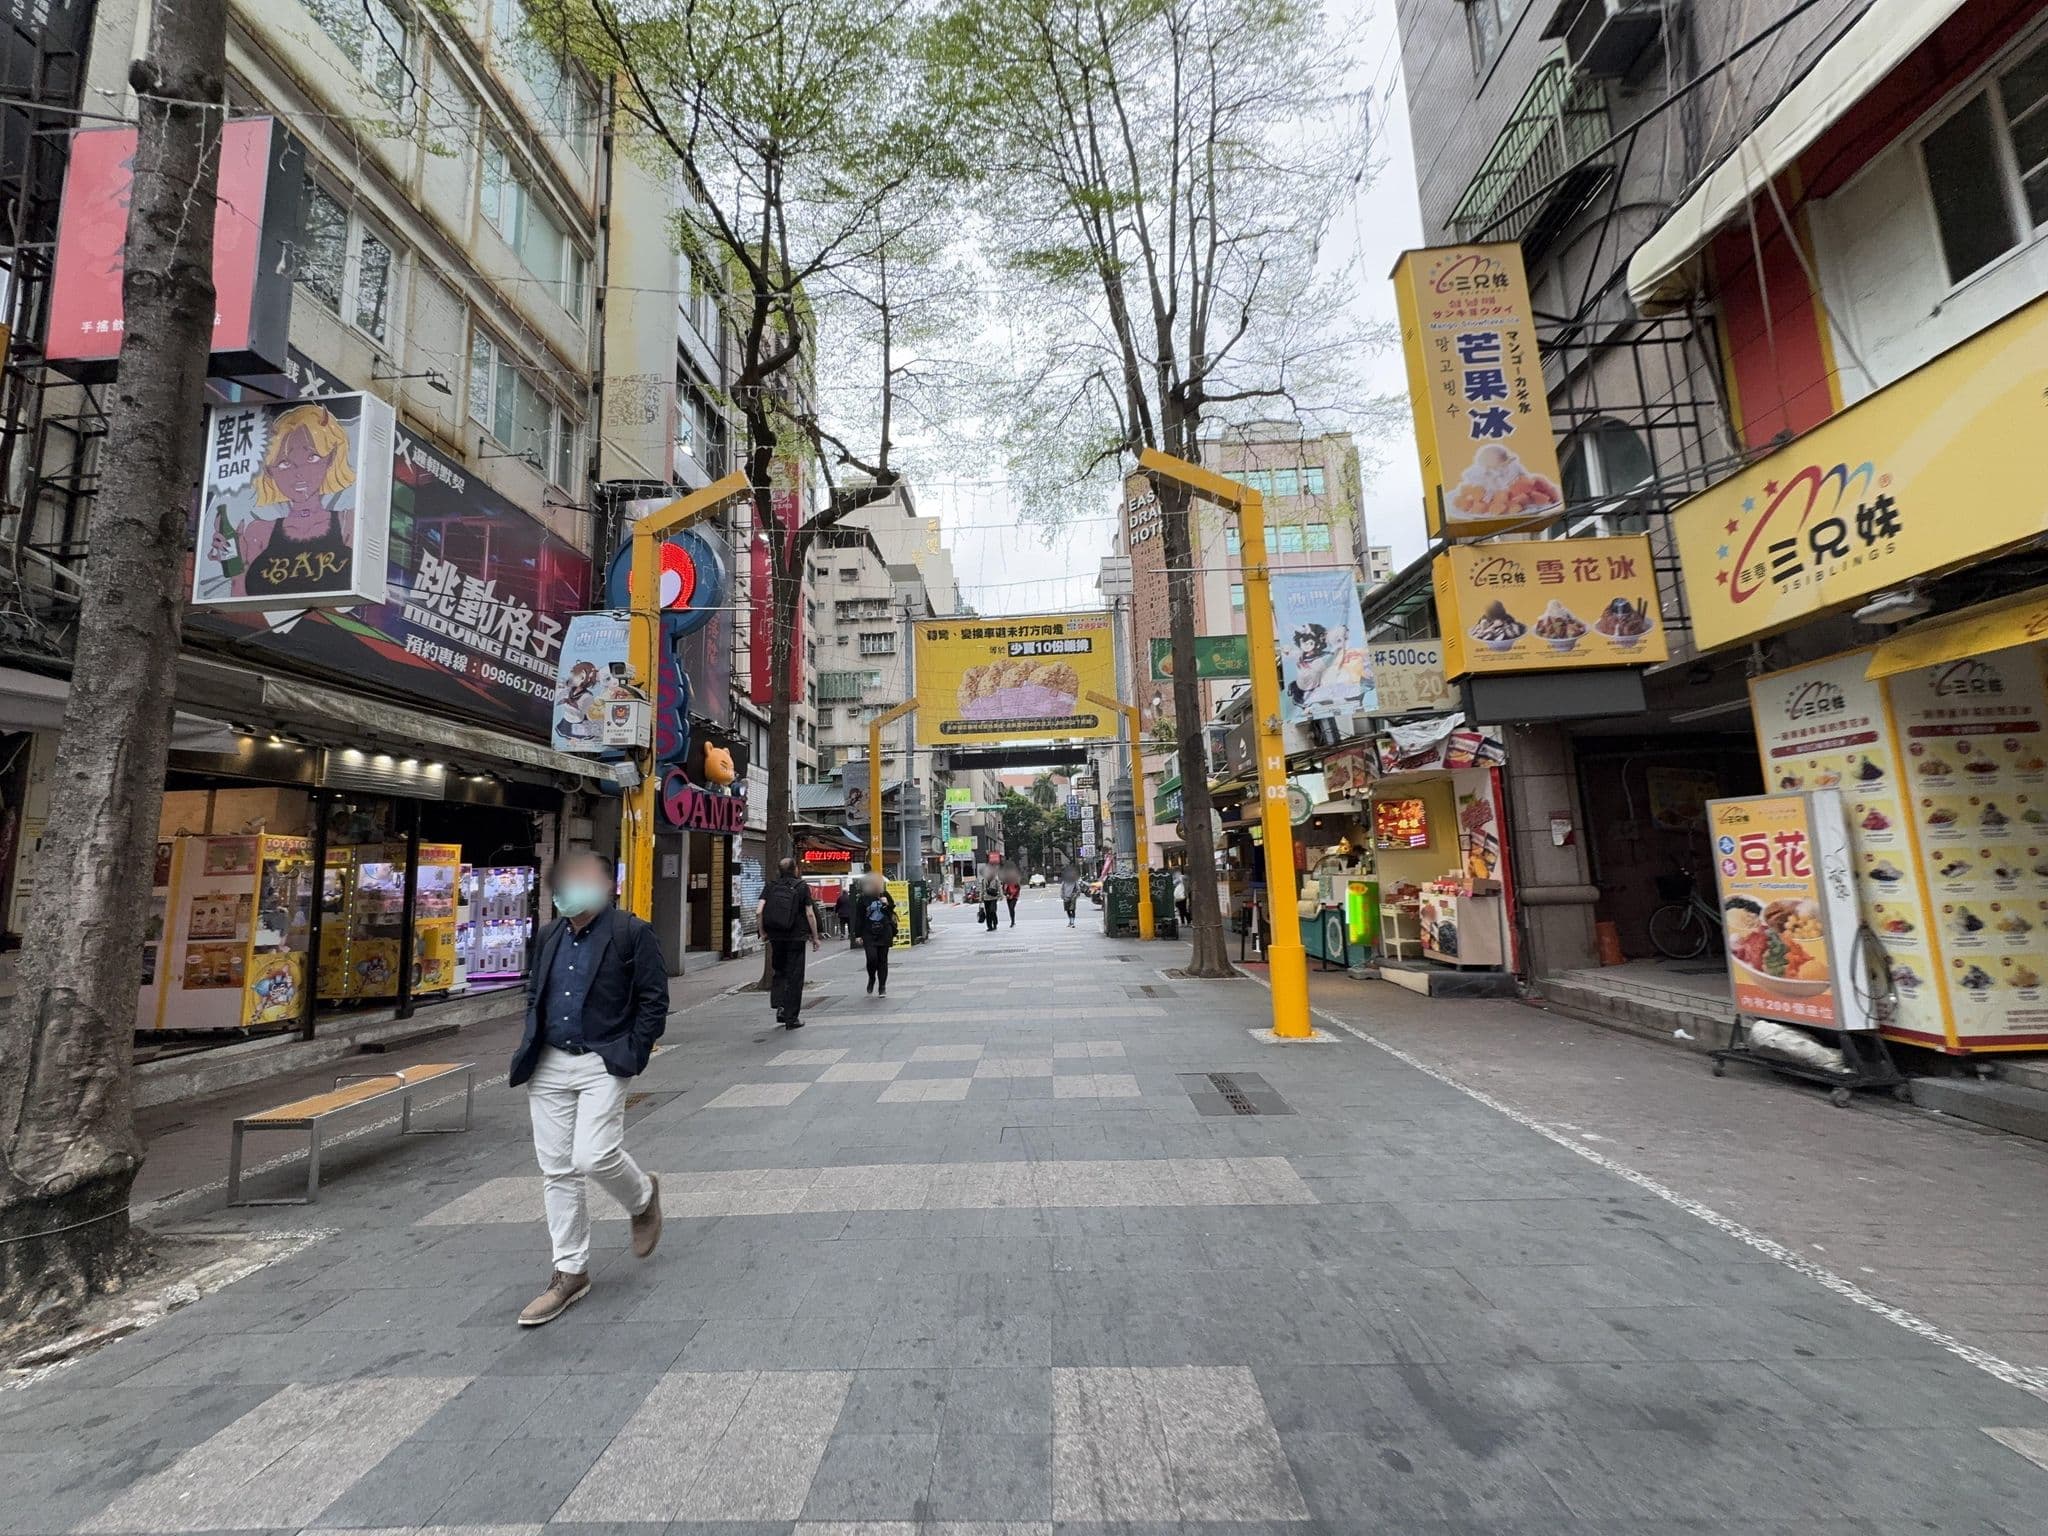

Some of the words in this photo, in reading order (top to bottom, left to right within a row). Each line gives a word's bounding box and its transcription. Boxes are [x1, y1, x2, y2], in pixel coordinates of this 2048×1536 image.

[1457, 332, 1515, 440] 芒果冰
[218, 459, 250, 479] BAR
[1128, 490, 1155, 512] EAS
[1129, 505, 1162, 528] DRA
[1768, 493, 1902, 585] 三兄妹
[260, 551, 349, 584] BAR
[1536, 555, 1637, 585] 雪花冰
[409, 548, 562, 659] 跳動格子
[402, 603, 504, 658] MOVING
[504, 645, 561, 680] GAME
[1370, 649, 1437, 666] 杯500cc
[1419, 676, 1443, 697] 20
[1267, 755, 1280, 770] H
[1267, 785, 1287, 799] 03
[1739, 830, 1811, 877] 豆花
